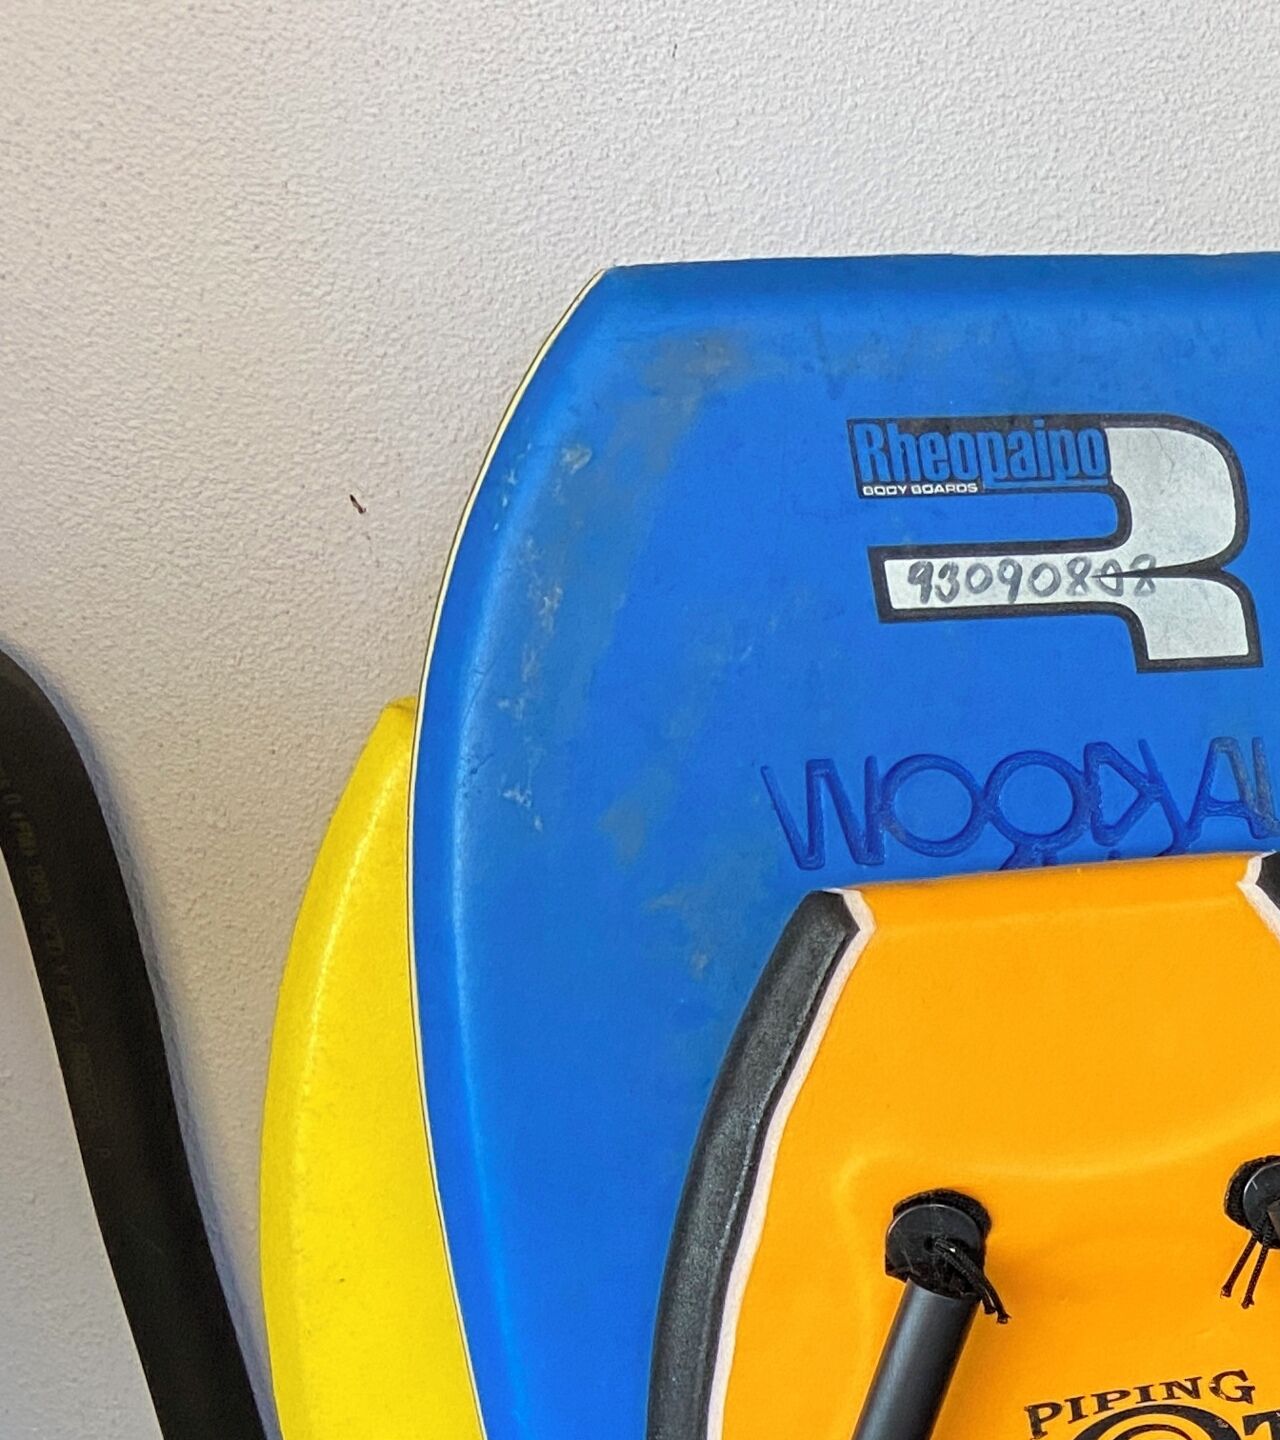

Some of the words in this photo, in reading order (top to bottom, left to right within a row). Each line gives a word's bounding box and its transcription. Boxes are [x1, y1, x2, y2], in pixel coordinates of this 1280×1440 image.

[852, 418, 1108, 489] Rheopaipo
[862, 484, 906, 496] BODY
[910, 483, 978, 495] BOARDS
